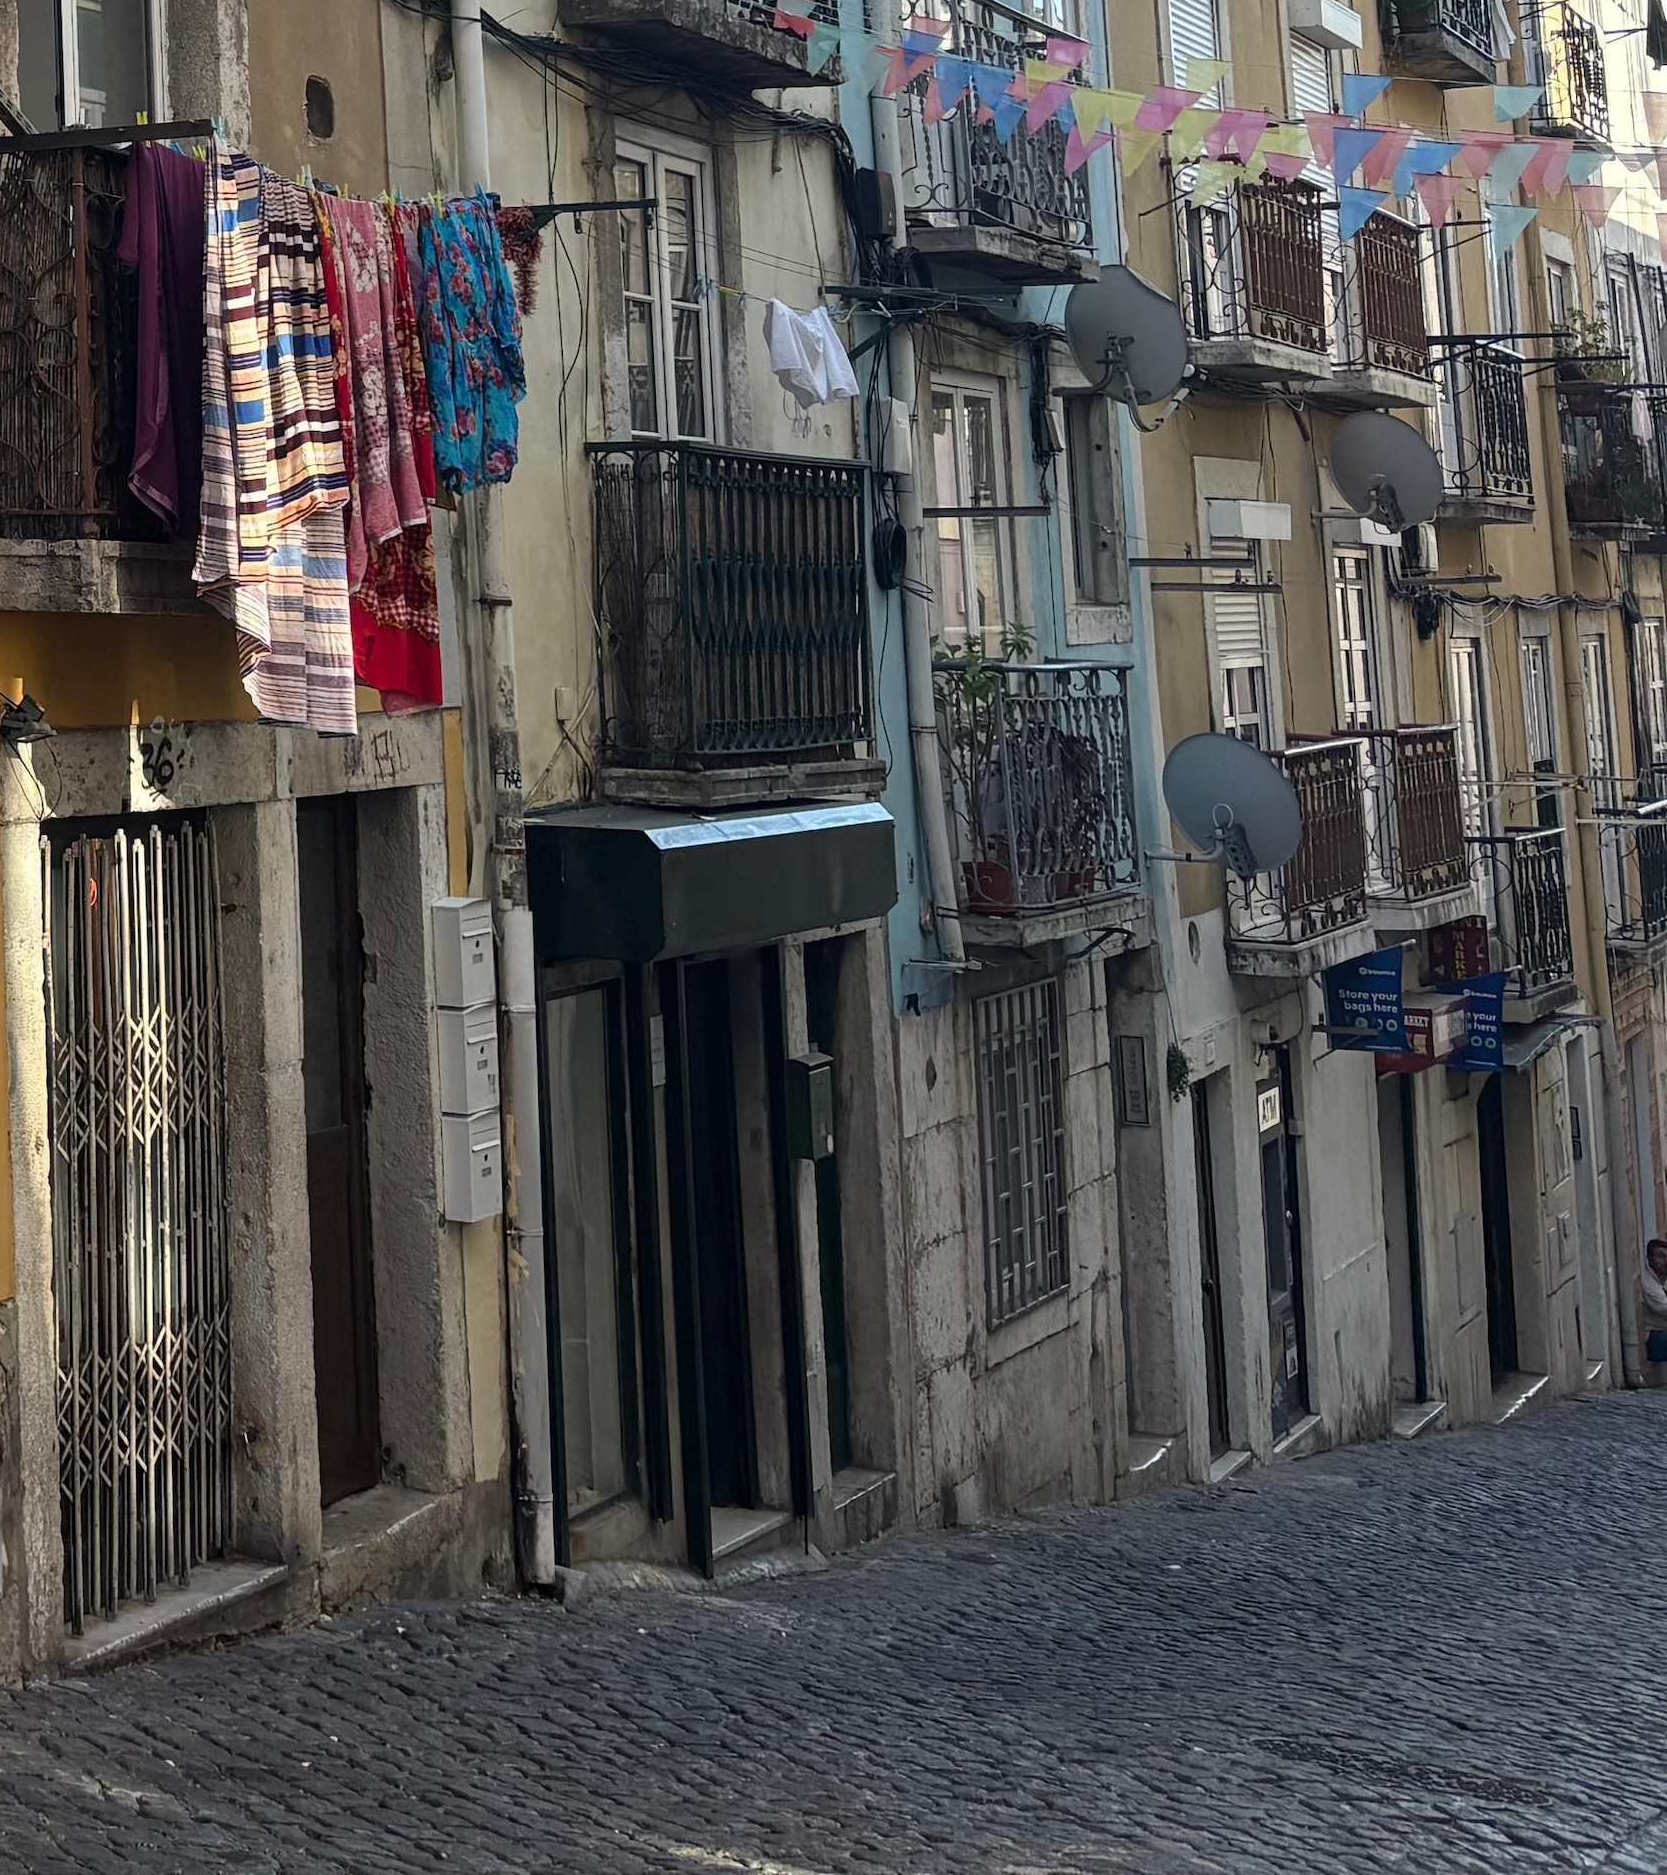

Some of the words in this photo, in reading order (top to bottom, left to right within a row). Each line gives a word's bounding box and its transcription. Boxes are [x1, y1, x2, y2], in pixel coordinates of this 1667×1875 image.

[1338, 988, 1369, 1000] Store
[1370, 992, 1398, 1005] your
[1343, 1000, 1372, 1013] bags
[1373, 1002, 1398, 1013] here
[1473, 1012, 1497, 1022] your
[1473, 1022, 1497, 1033] here
[1261, 1093, 1277, 1124] ATM
